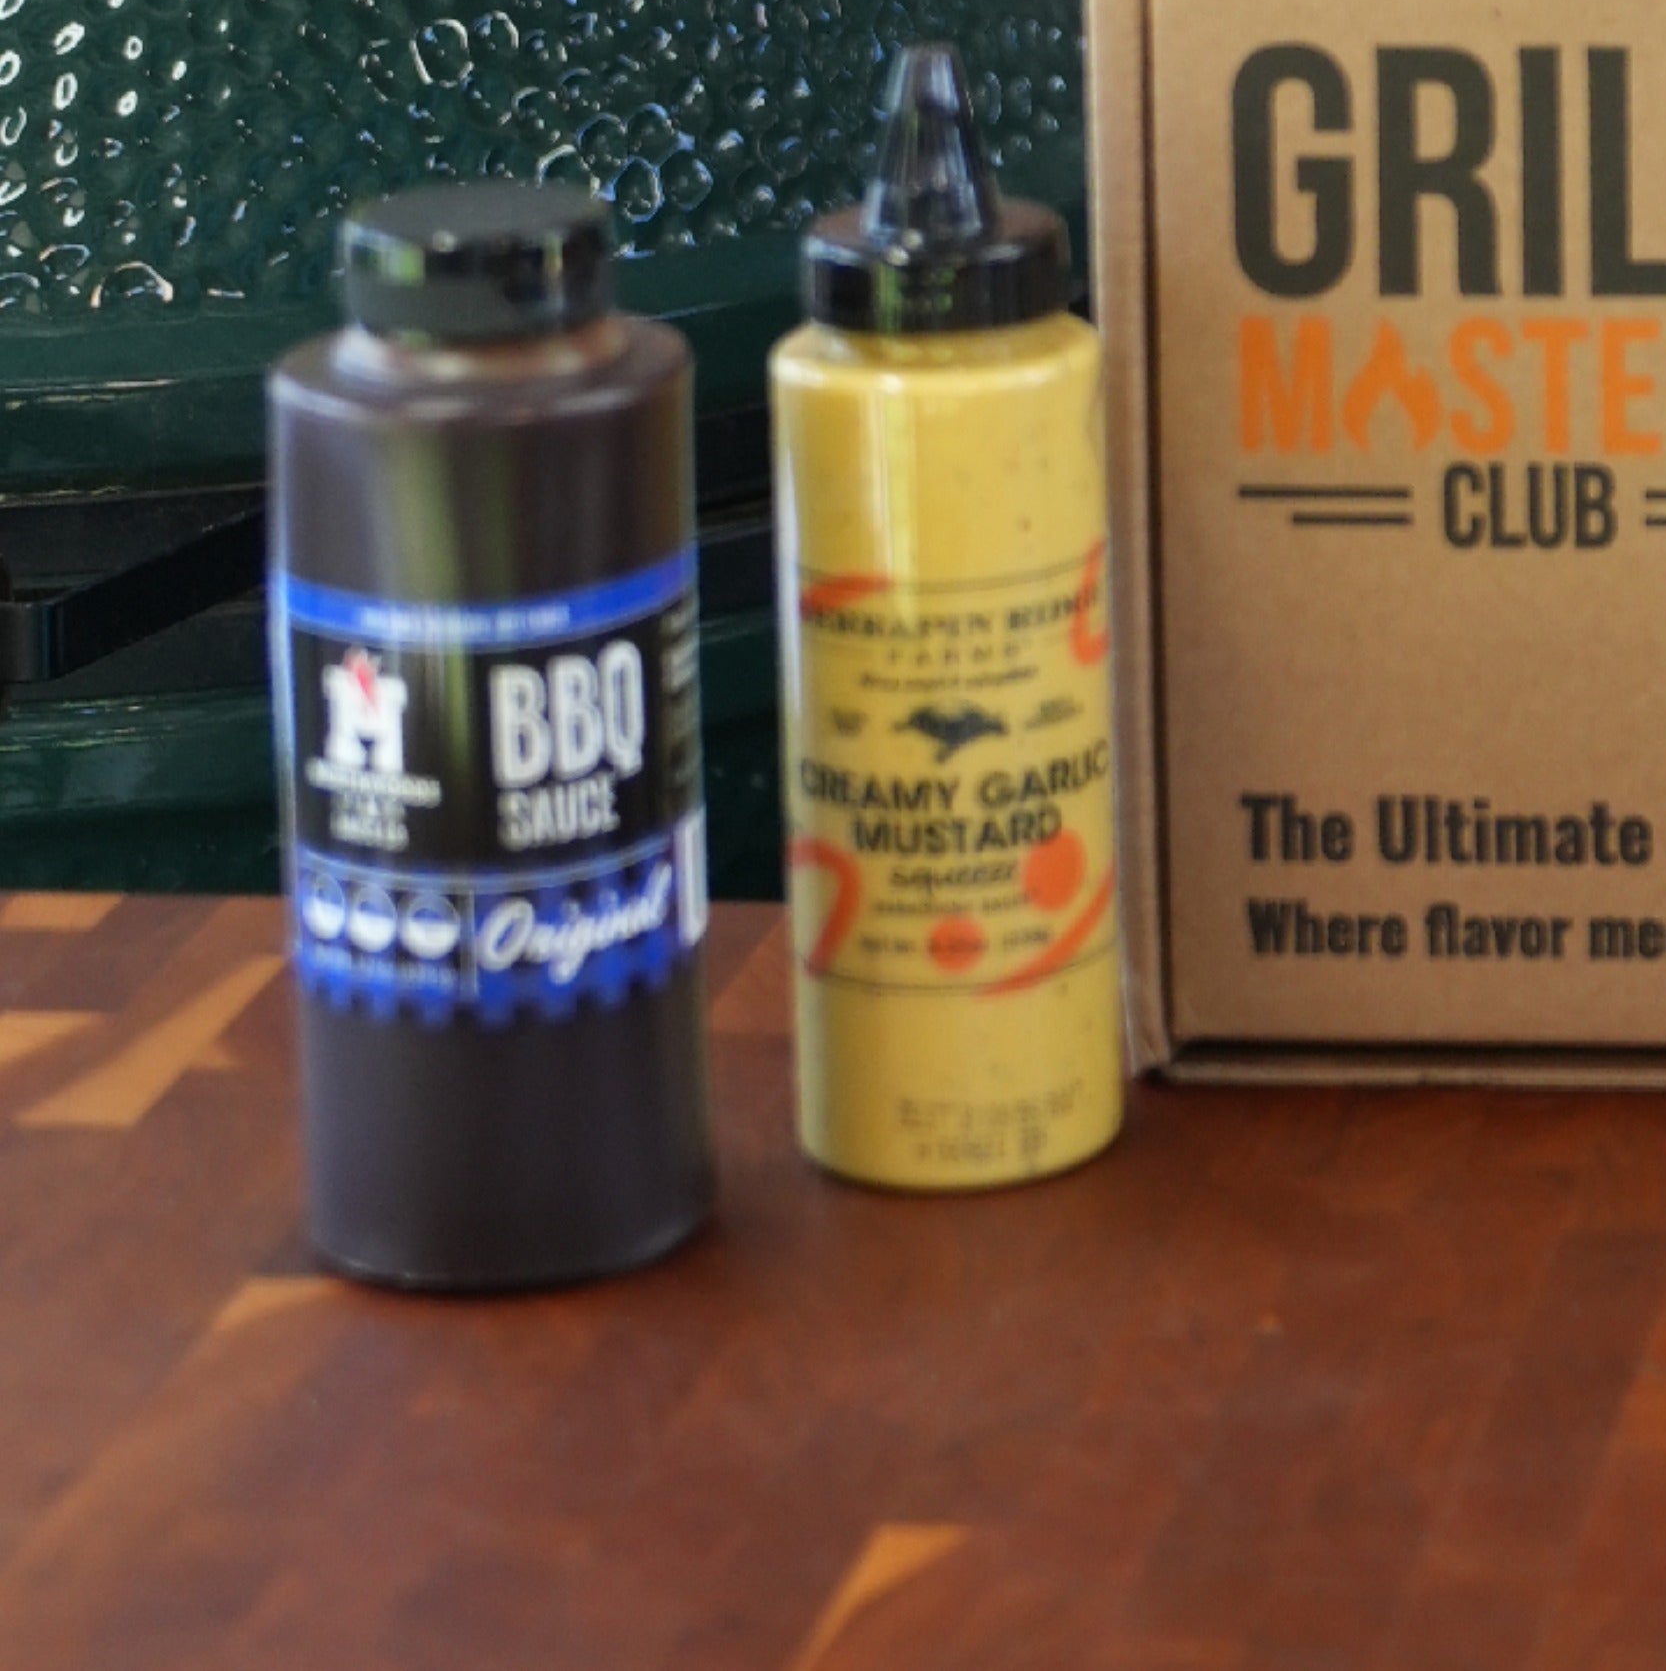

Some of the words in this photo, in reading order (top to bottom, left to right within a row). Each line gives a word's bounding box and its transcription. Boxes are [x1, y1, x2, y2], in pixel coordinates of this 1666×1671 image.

[1443, 462, 1619, 550] CLUB
[489, 639, 646, 791] BBQ
[801, 761, 961, 810] CREAMY
[979, 739, 1109, 807] GARLIC
[500, 774, 620, 851] SAUCE
[853, 801, 1062, 854] MUSTARD
[1240, 794, 1353, 863] The
[1376, 795, 1653, 866] Ultimate
[477, 862, 672, 985] Original
[1247, 899, 1406, 959] Where
[1425, 902, 1572, 961] flavor
